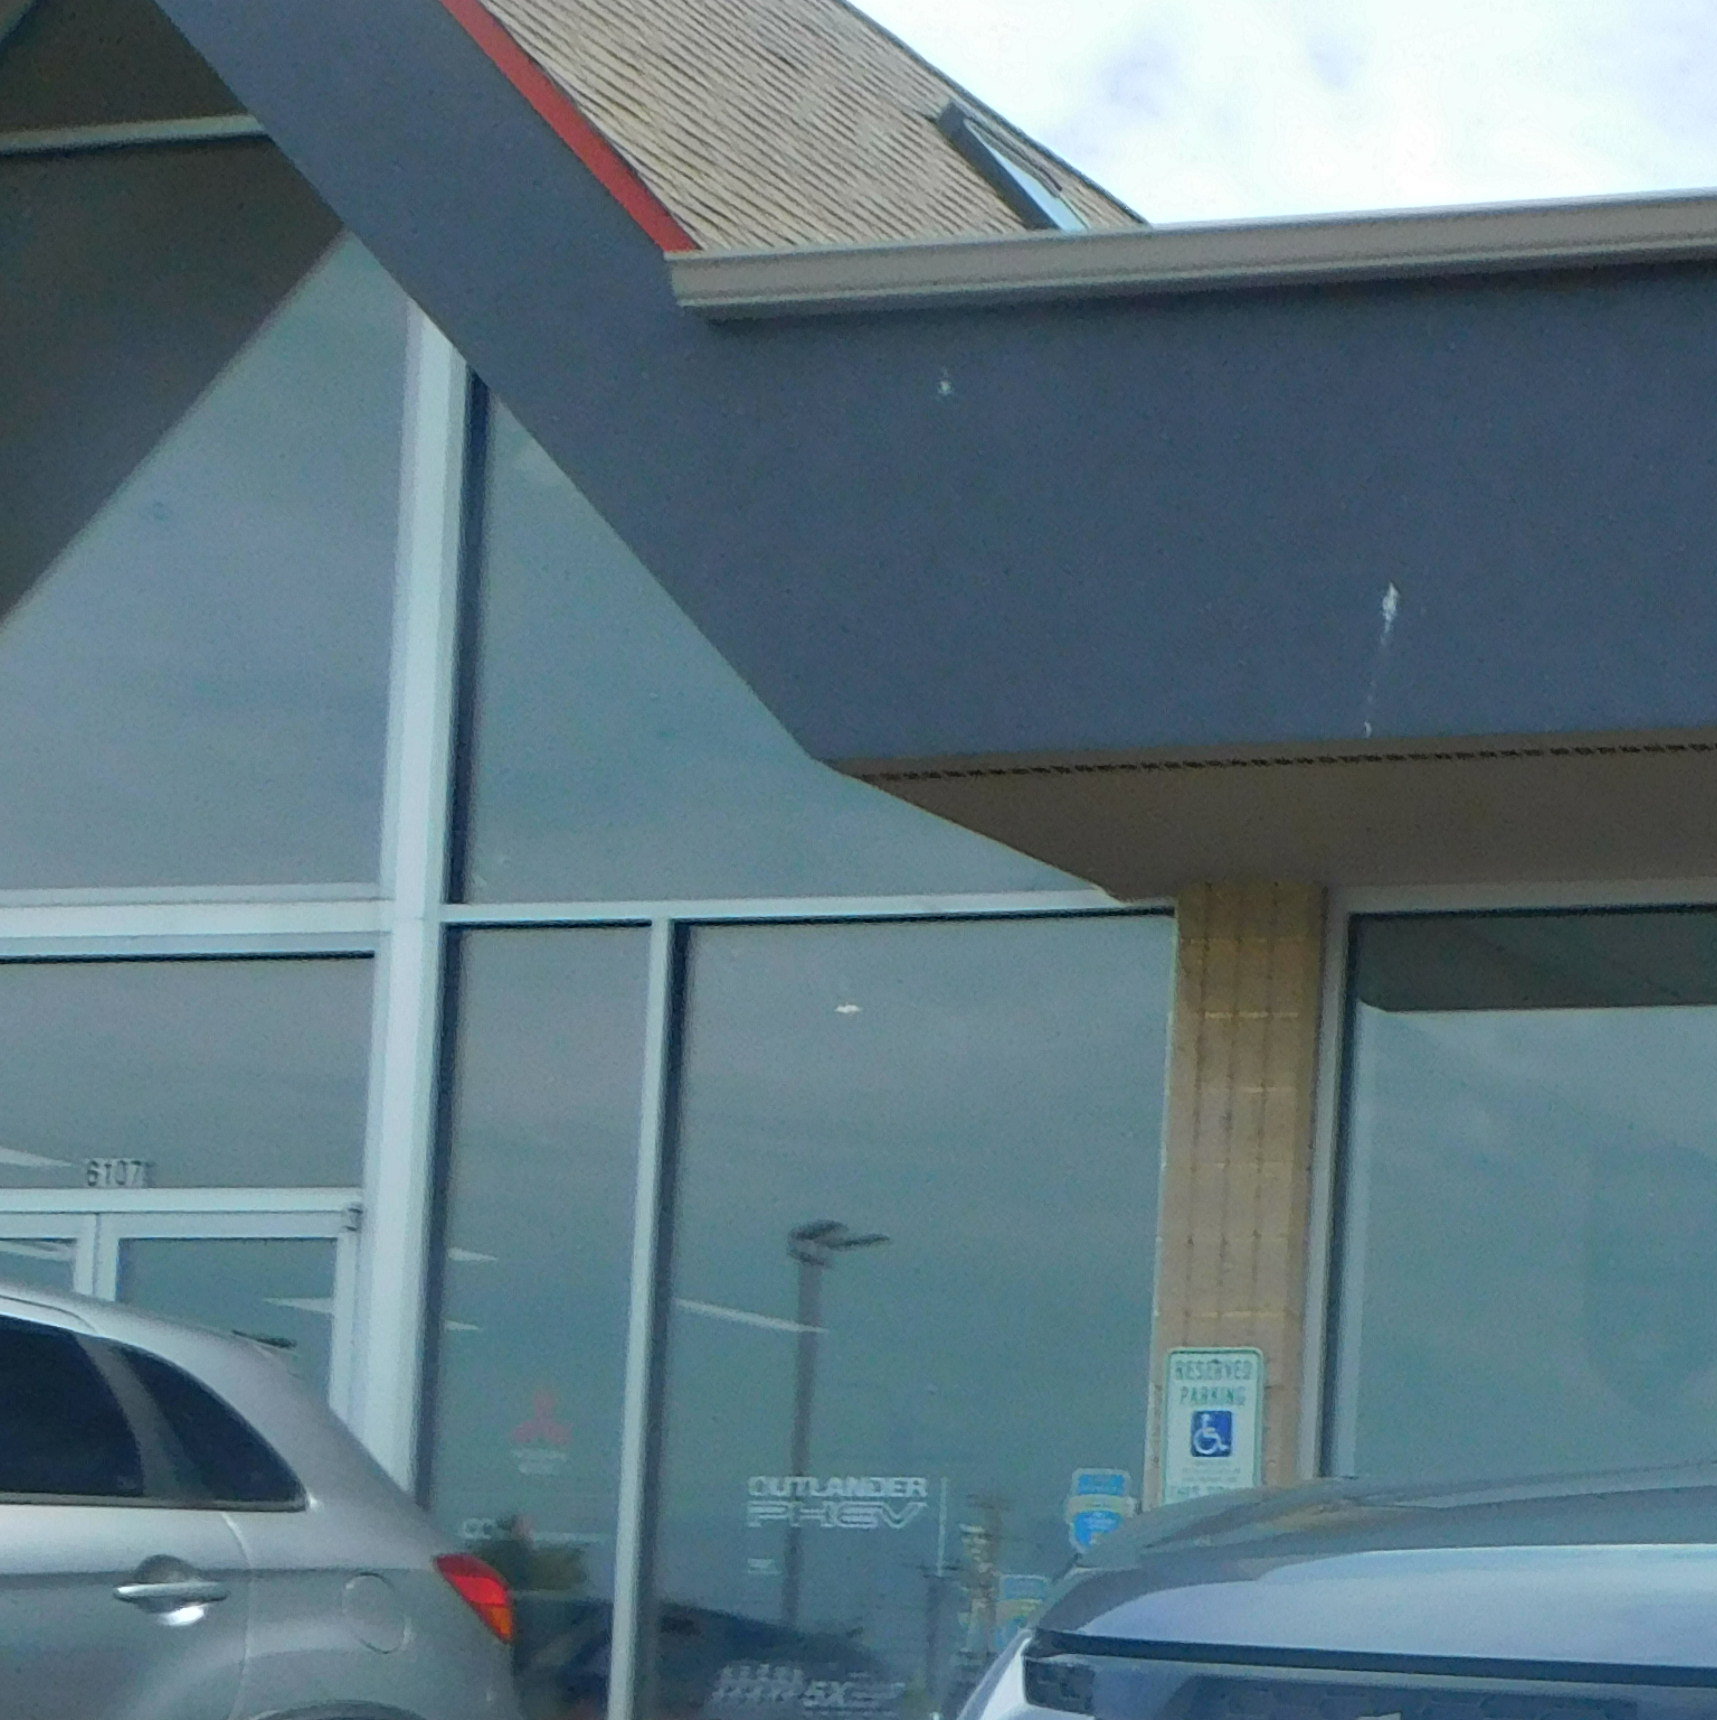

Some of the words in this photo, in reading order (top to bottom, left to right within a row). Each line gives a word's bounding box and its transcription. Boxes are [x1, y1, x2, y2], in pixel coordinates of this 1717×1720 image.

[1174, 1360, 1253, 1380] RESERVED
[1180, 1386, 1245, 1405] PARKING
[748, 1476, 928, 1497] OUTLANDER
[747, 1501, 927, 1528] PHEV
